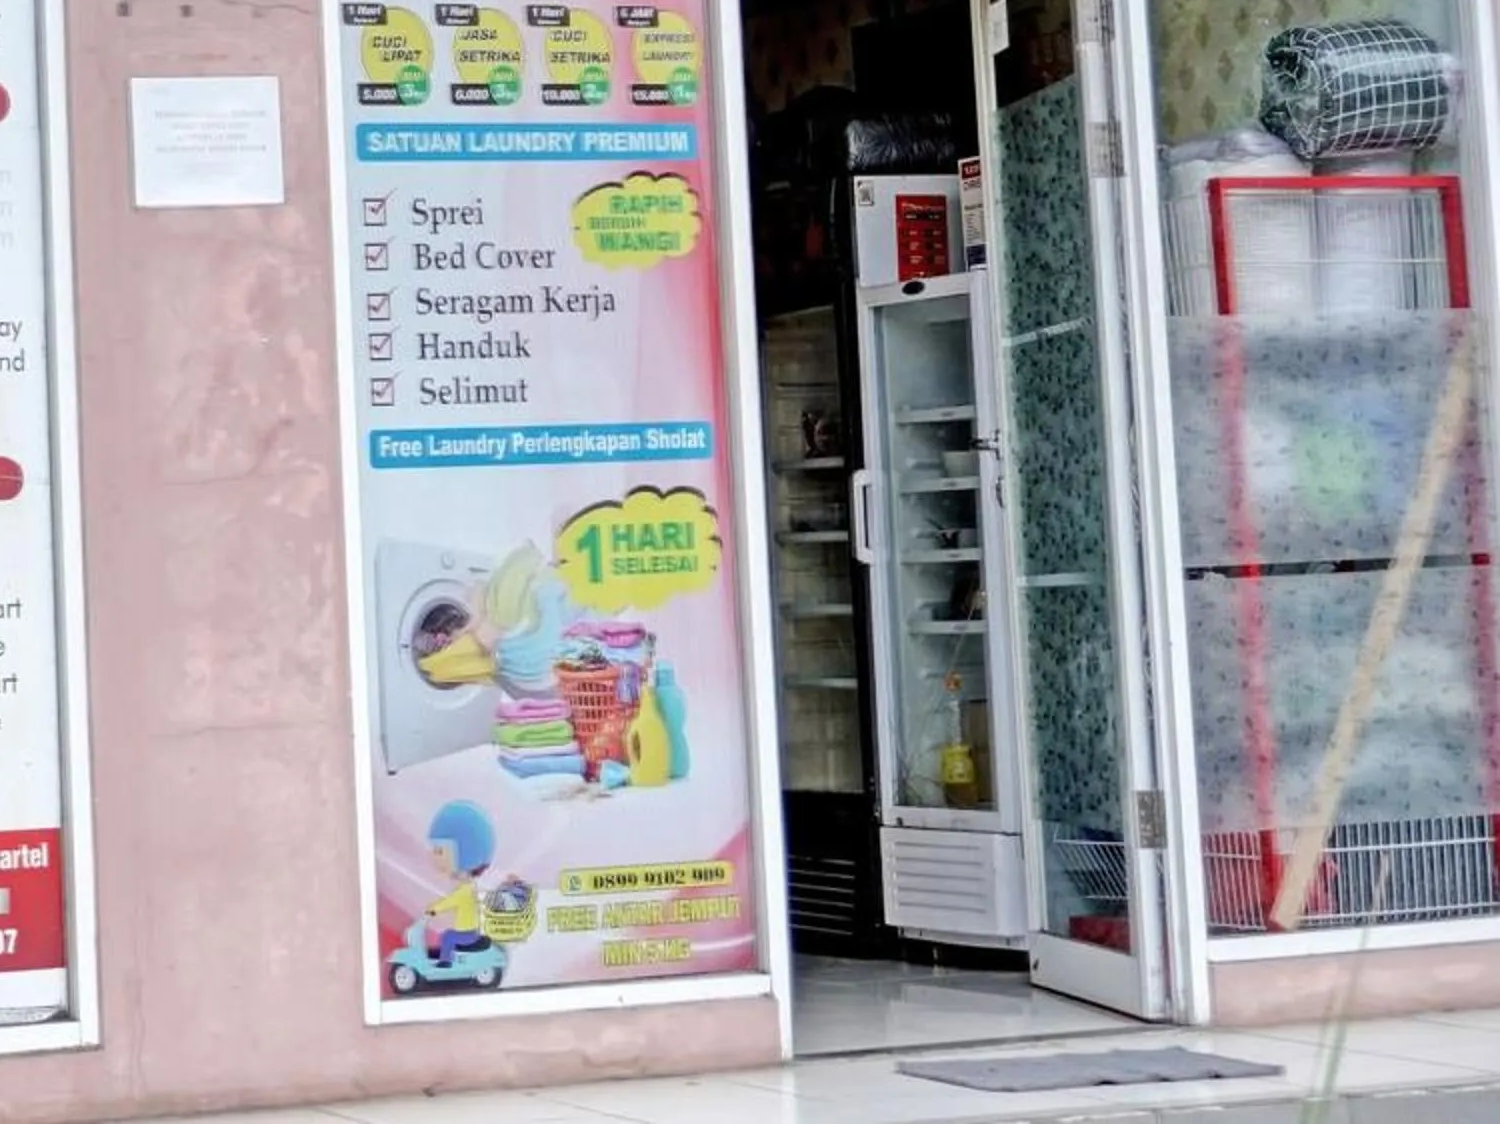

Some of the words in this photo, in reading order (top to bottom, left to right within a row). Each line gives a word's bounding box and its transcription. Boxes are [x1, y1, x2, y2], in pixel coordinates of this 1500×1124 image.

[461, 28, 498, 41] JASA
[460, 51, 521, 62] SETRIKA
[551, 52, 610, 62] SETRIKA
[367, 132, 461, 153] SATUAN
[469, 132, 573, 152] LAUNDRY
[584, 131, 688, 152] PREMIUM
[412, 198, 484, 233] Sprei
[414, 243, 466, 270] Bed
[476, 242, 556, 269] Cover
[416, 288, 533, 323] Seragam
[542, 286, 615, 320] Kerja
[418, 332, 531, 360] Handuk
[420, 377, 528, 405] Selimut
[380, 436, 423, 457] Free
[429, 433, 506, 459] Laundry
[513, 431, 640, 457] Perlengkapan
[647, 428, 706, 450] Sholat
[577, 526, 603, 583] 1
[612, 523, 695, 552] HARI
[612, 556, 698, 575] SELESAI
